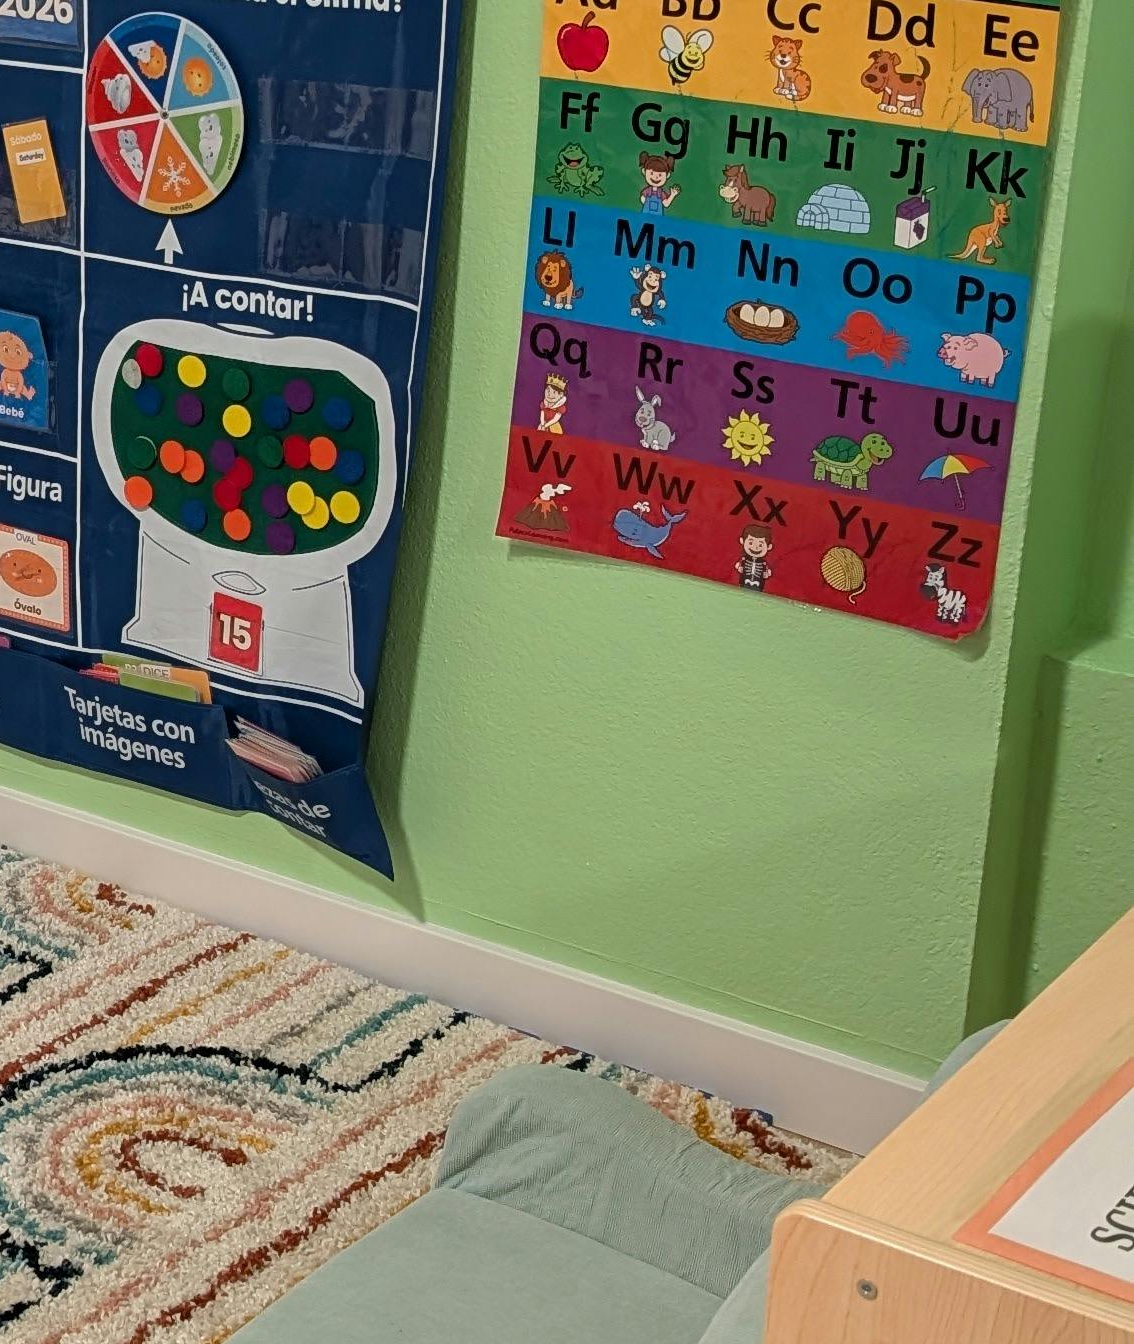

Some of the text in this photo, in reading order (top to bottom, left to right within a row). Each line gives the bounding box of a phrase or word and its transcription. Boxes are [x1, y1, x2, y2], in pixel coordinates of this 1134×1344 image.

[983, 14, 1040, 63] Ee
[9, 131, 43, 146] Sábado
[559, 90, 1029, 199] Ff Gg Hh Ii Jj Kk
[542, 207, 1017, 334] Ll Mm Nn Oo Pp
[182, 281, 313, 322] ¡A contar!
[528, 322, 1001, 447] Qq Rr Ss Tt Uu
[0, 404, 25, 419] Bebé
[521, 436, 984, 569] Vv Ww Xx Yy Zz
[16, 532, 36, 546] OVAL
[219, 613, 252, 651] 15
[64, 685, 195, 744] Tarjetas con
[78, 717, 186, 769] imágenes
[297, 799, 332, 819] de
